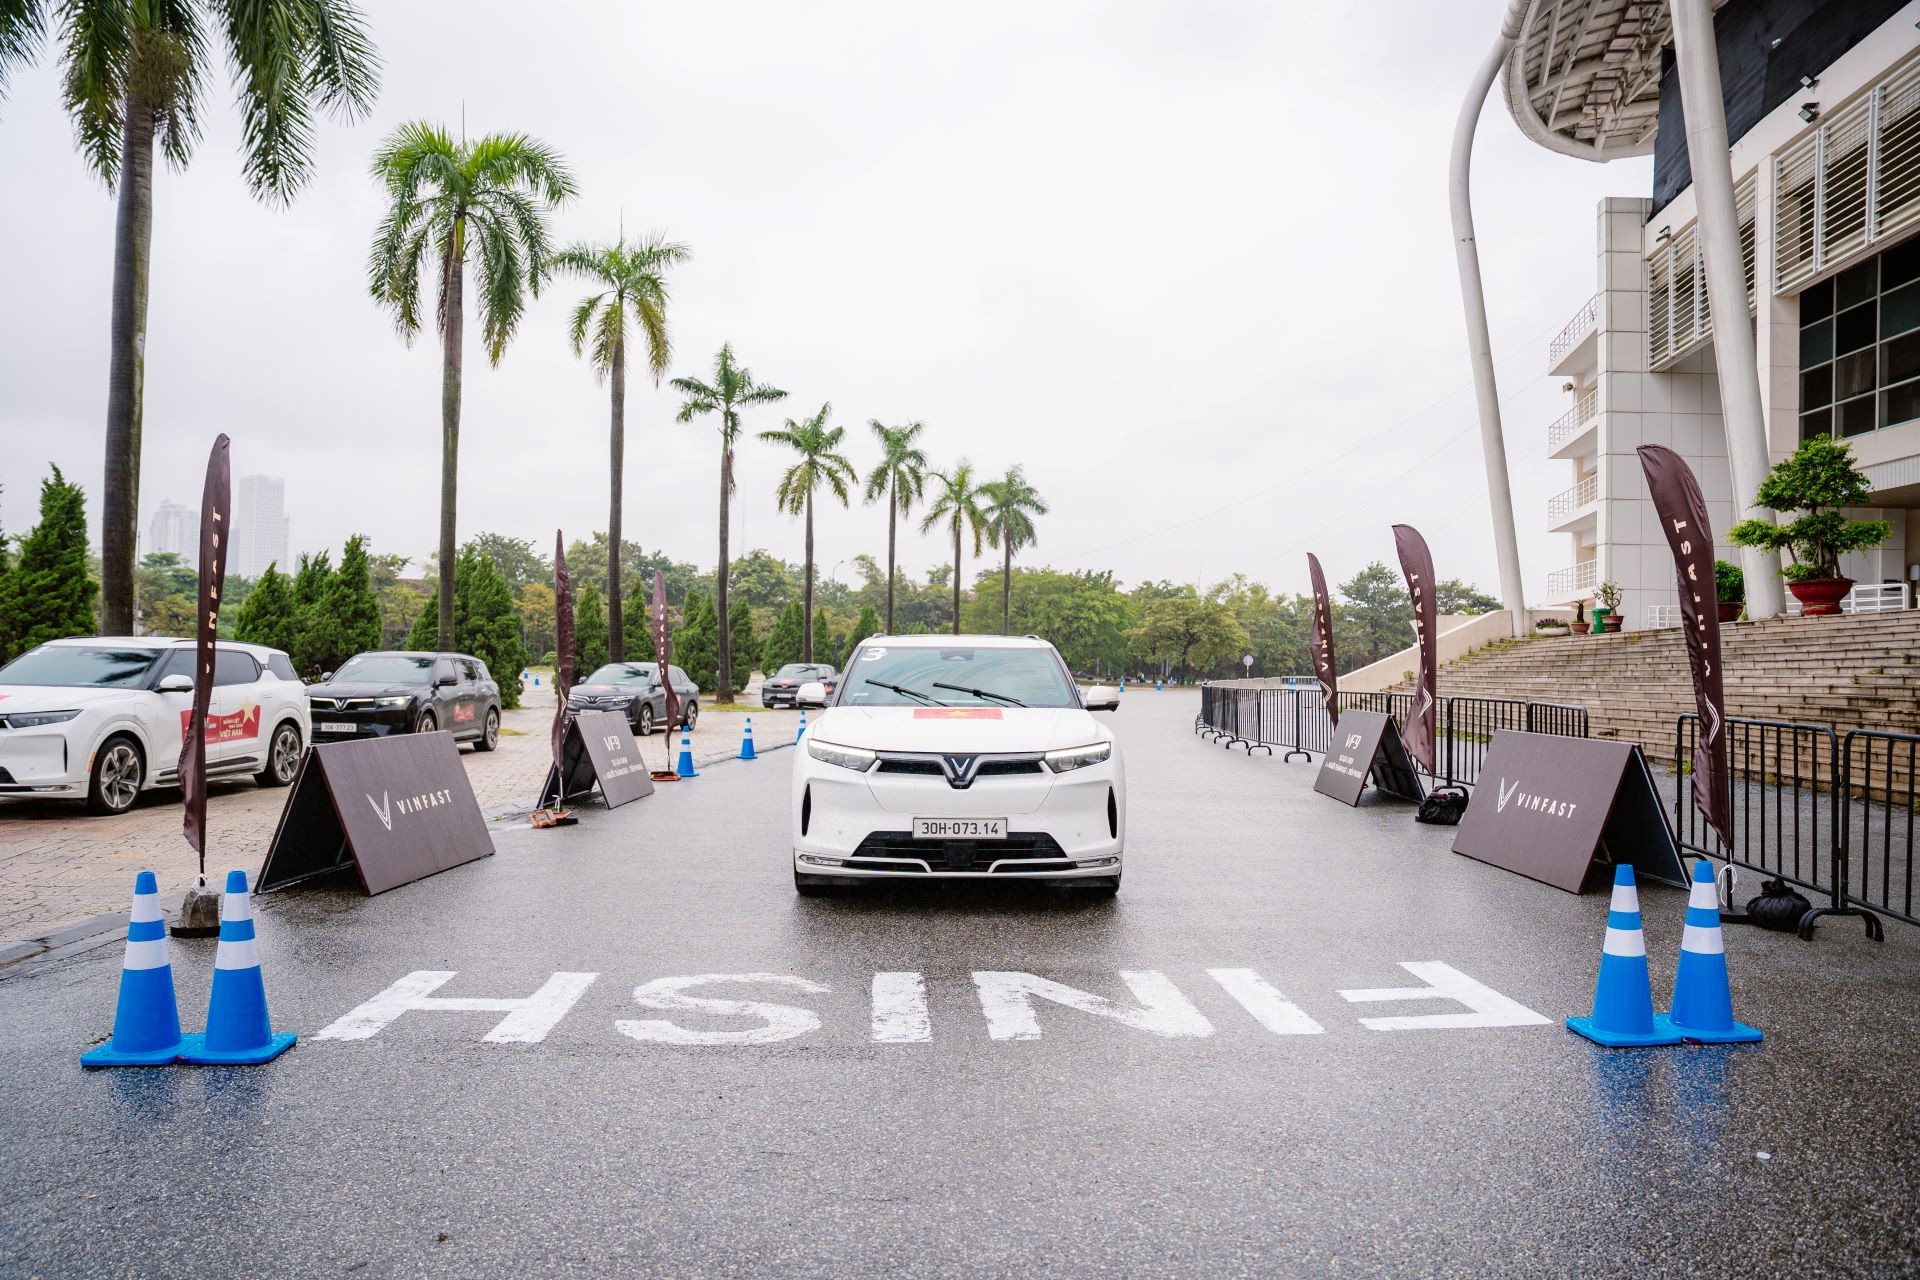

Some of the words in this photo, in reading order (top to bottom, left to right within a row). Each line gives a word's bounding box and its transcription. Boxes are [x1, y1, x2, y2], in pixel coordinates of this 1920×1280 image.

[860, 647, 888, 661] 3
[604, 735, 621, 751] VF9
[1345, 733, 1361, 750] VF9
[396, 789, 451, 814] VINFAST
[1517, 793, 1576, 818] VINFAST
[922, 822, 998, 834] 30H-073.14
[311, 961, 1554, 1045] FINISH
